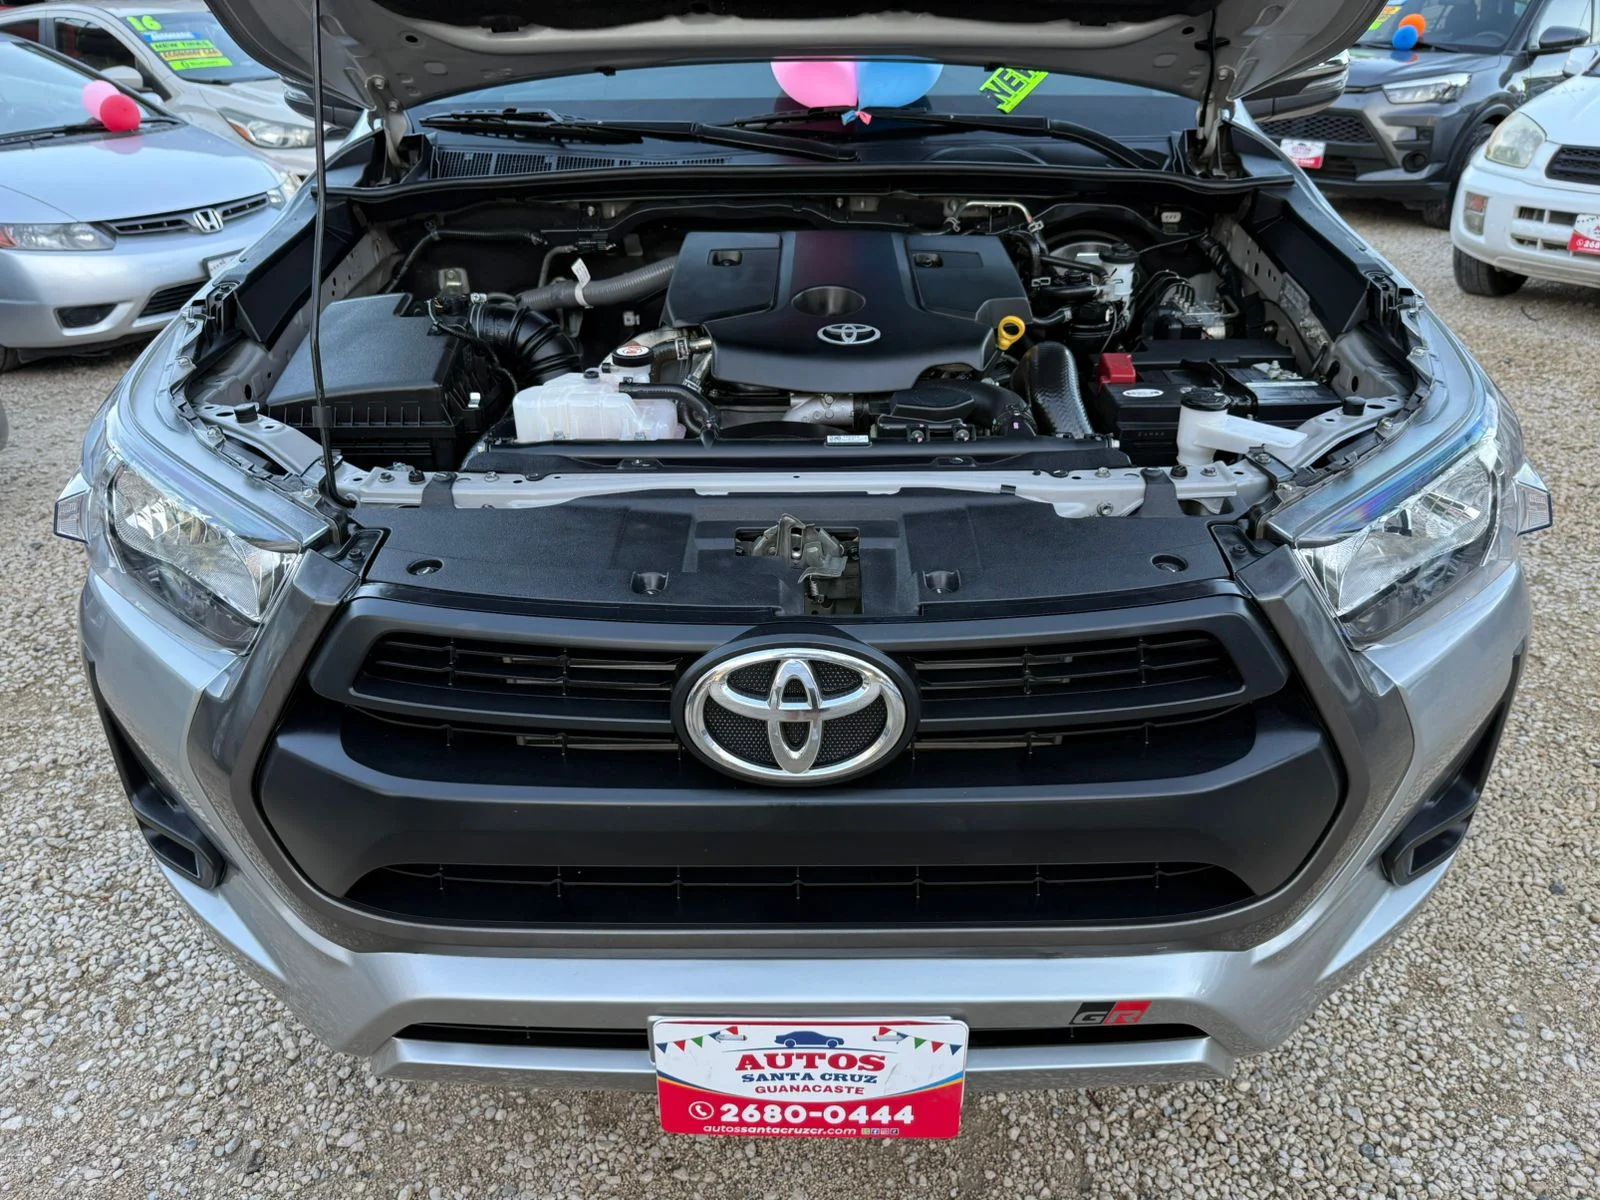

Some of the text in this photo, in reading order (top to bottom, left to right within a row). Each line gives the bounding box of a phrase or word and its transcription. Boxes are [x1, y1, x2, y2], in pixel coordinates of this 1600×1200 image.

[126, 15, 162, 31] 16
[735, 1052, 885, 1071] AUTOS
[741, 1072, 878, 1083] SANTA CRUZ
[755, 1084, 865, 1095] GUANACASTE
[719, 1103, 914, 1124] 2680-0444
[703, 1124, 857, 1135] autossantacruzcr.com
